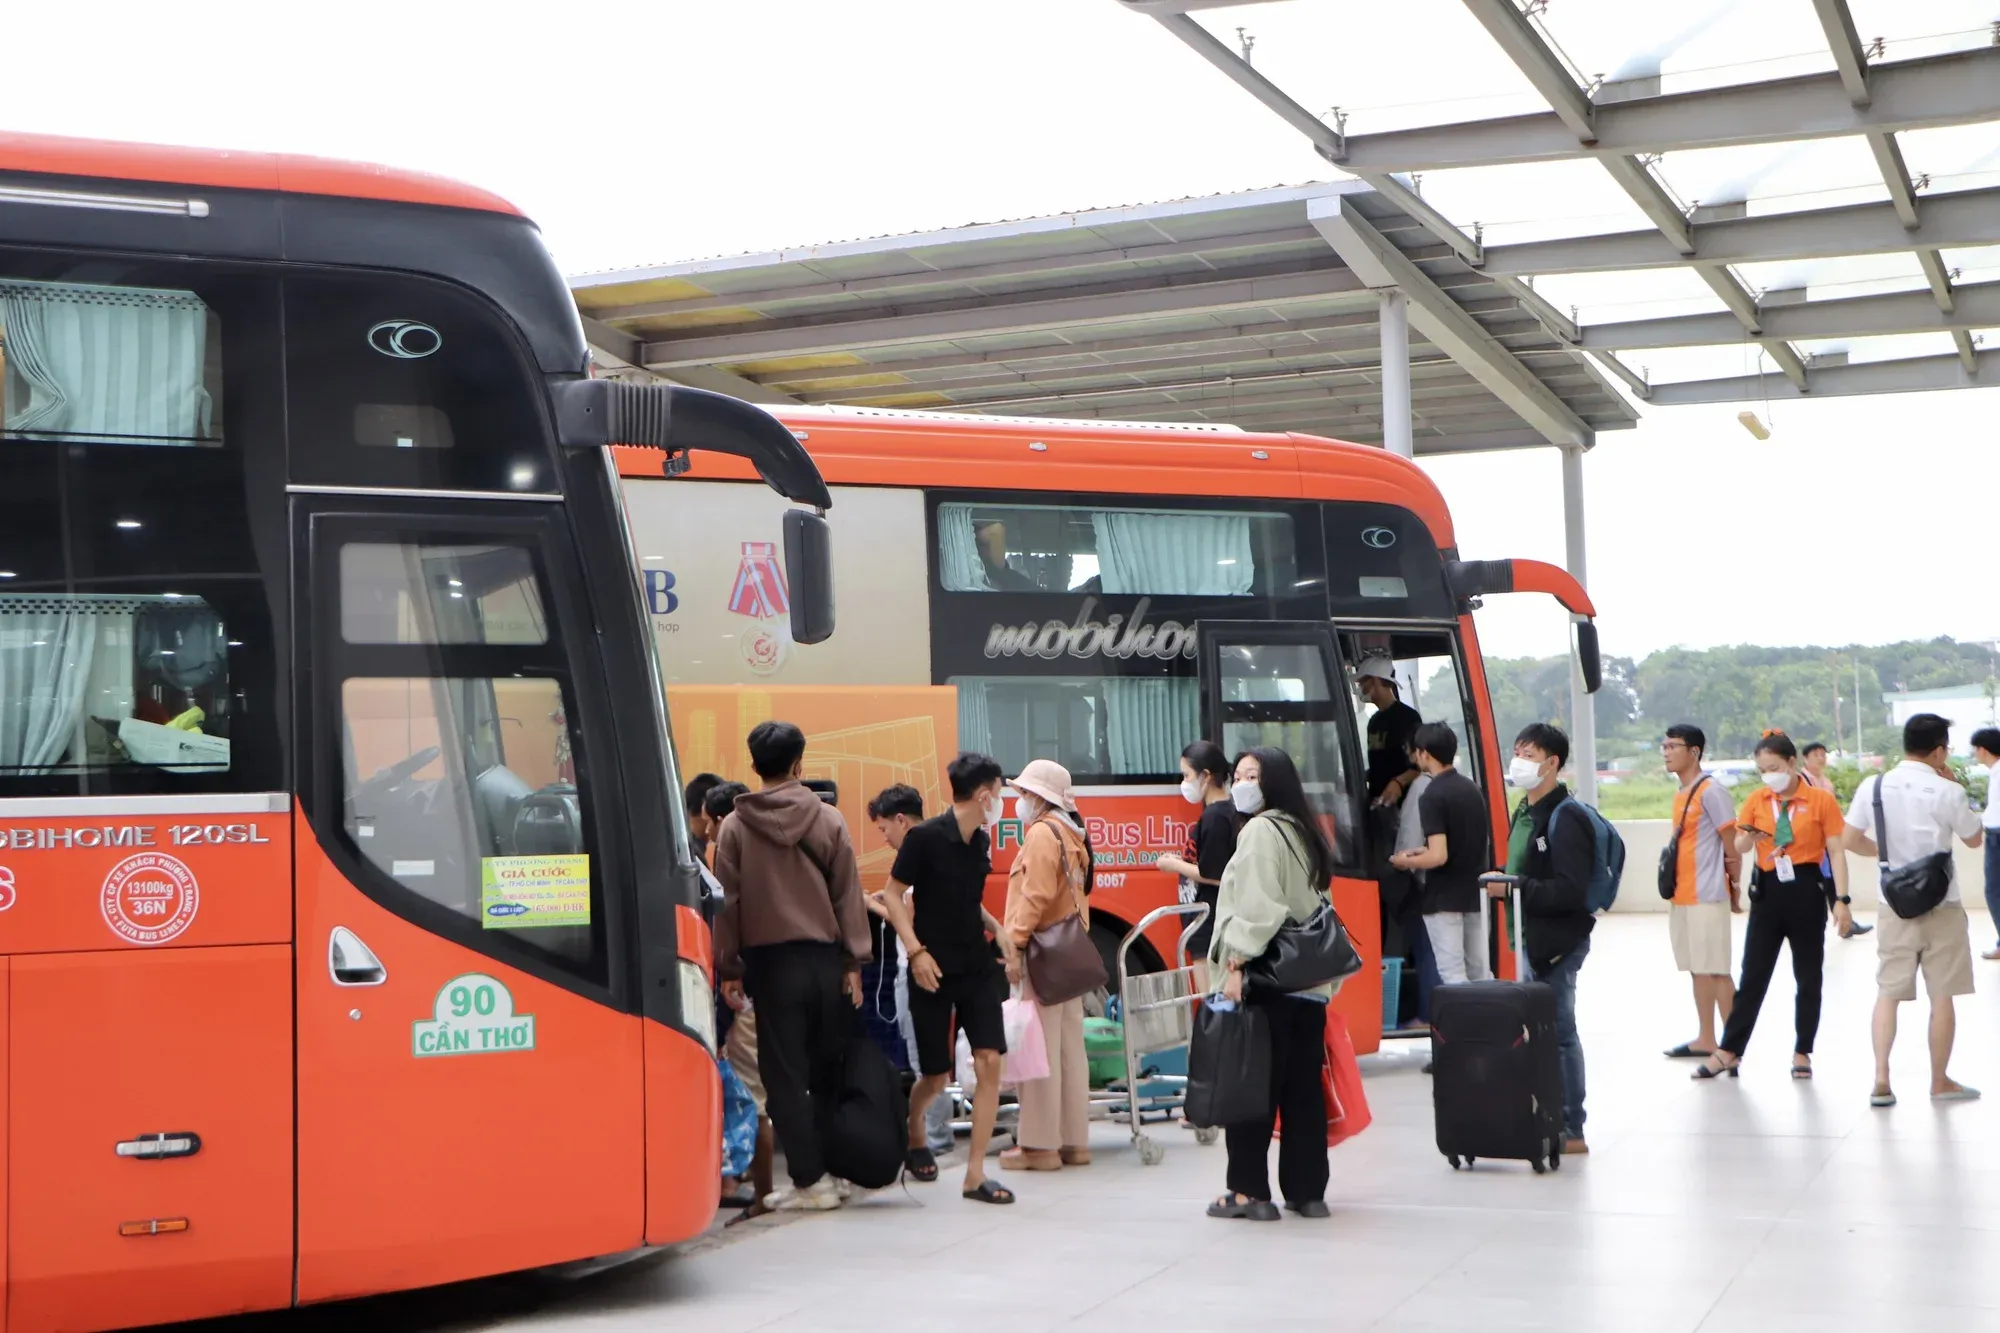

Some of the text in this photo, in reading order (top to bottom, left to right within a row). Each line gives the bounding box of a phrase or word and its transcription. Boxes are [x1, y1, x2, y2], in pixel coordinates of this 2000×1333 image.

[168, 823, 269, 845] 120SL
[1085, 816, 1142, 848] Bus
[1117, 849, 1137, 866] LÀ
[501, 866, 571, 879] GIÁ CƯỚC
[1096, 873, 1126, 888] 6067
[113, 870, 125, 882] XE
[182, 883, 194, 913] TRANG
[127, 881, 174, 896] 13100kg
[133, 900, 166, 916] 36N
[115, 918, 184, 940] FUTA BUS LINES
[450, 984, 496, 1017] 90
[419, 1021, 528, 1052] CẦN THƠ
